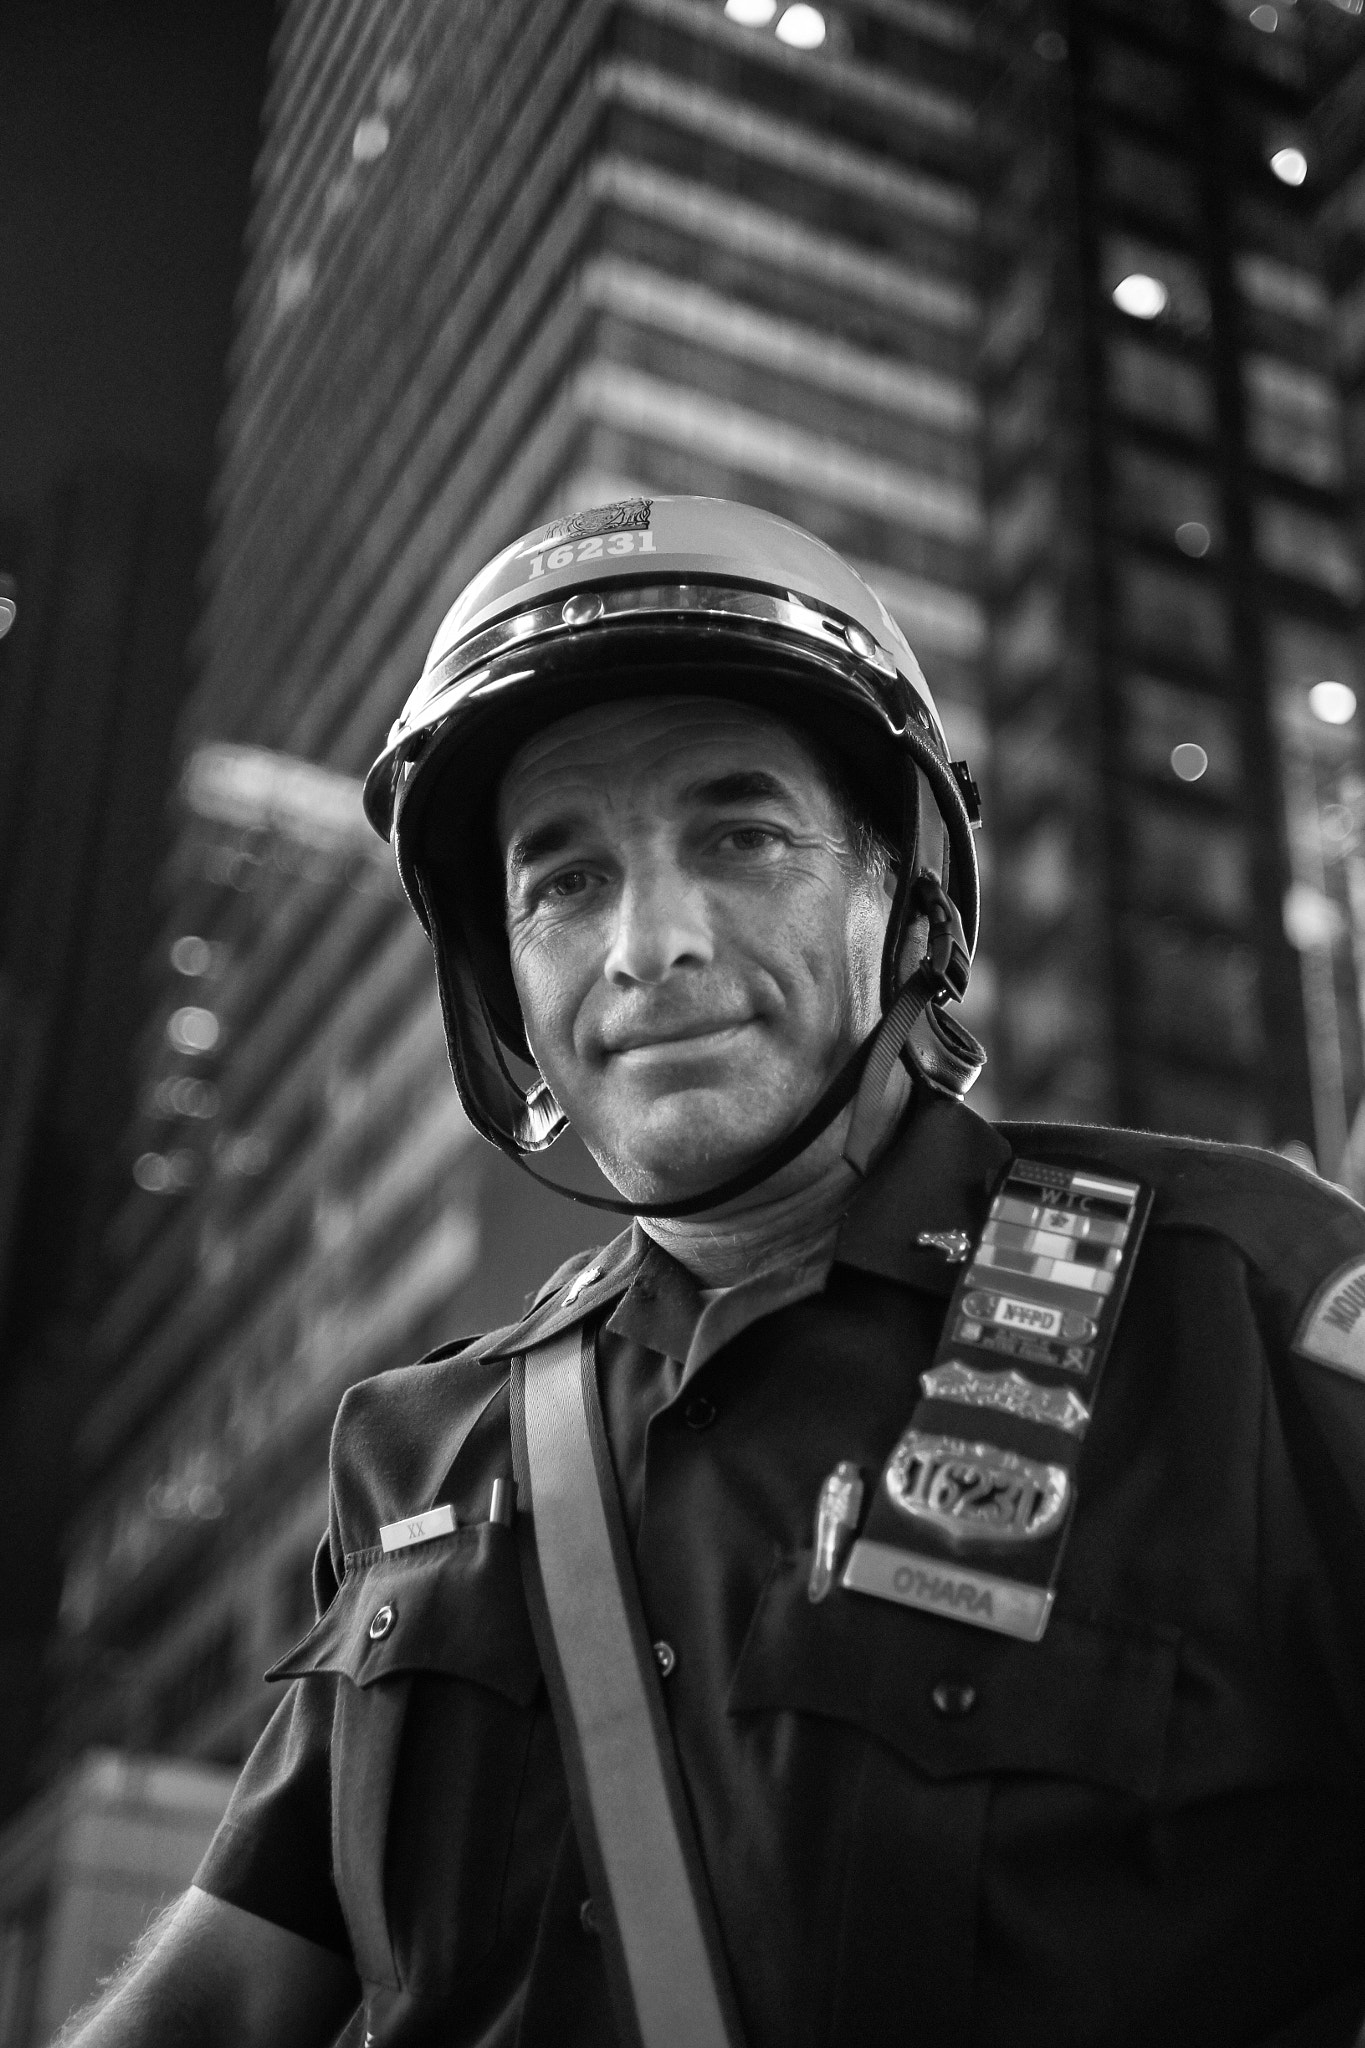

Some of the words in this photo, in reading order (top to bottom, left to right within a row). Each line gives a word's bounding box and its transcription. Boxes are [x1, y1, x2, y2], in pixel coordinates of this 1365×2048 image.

[529, 531, 656, 580] 16231
[1041, 1187, 1091, 1212] WTC
[1002, 1303, 1055, 1329] NYPD
[900, 1453, 1044, 1532] 16231
[407, 1521, 425, 1539] XX
[894, 1566, 994, 1618] O'HARA
